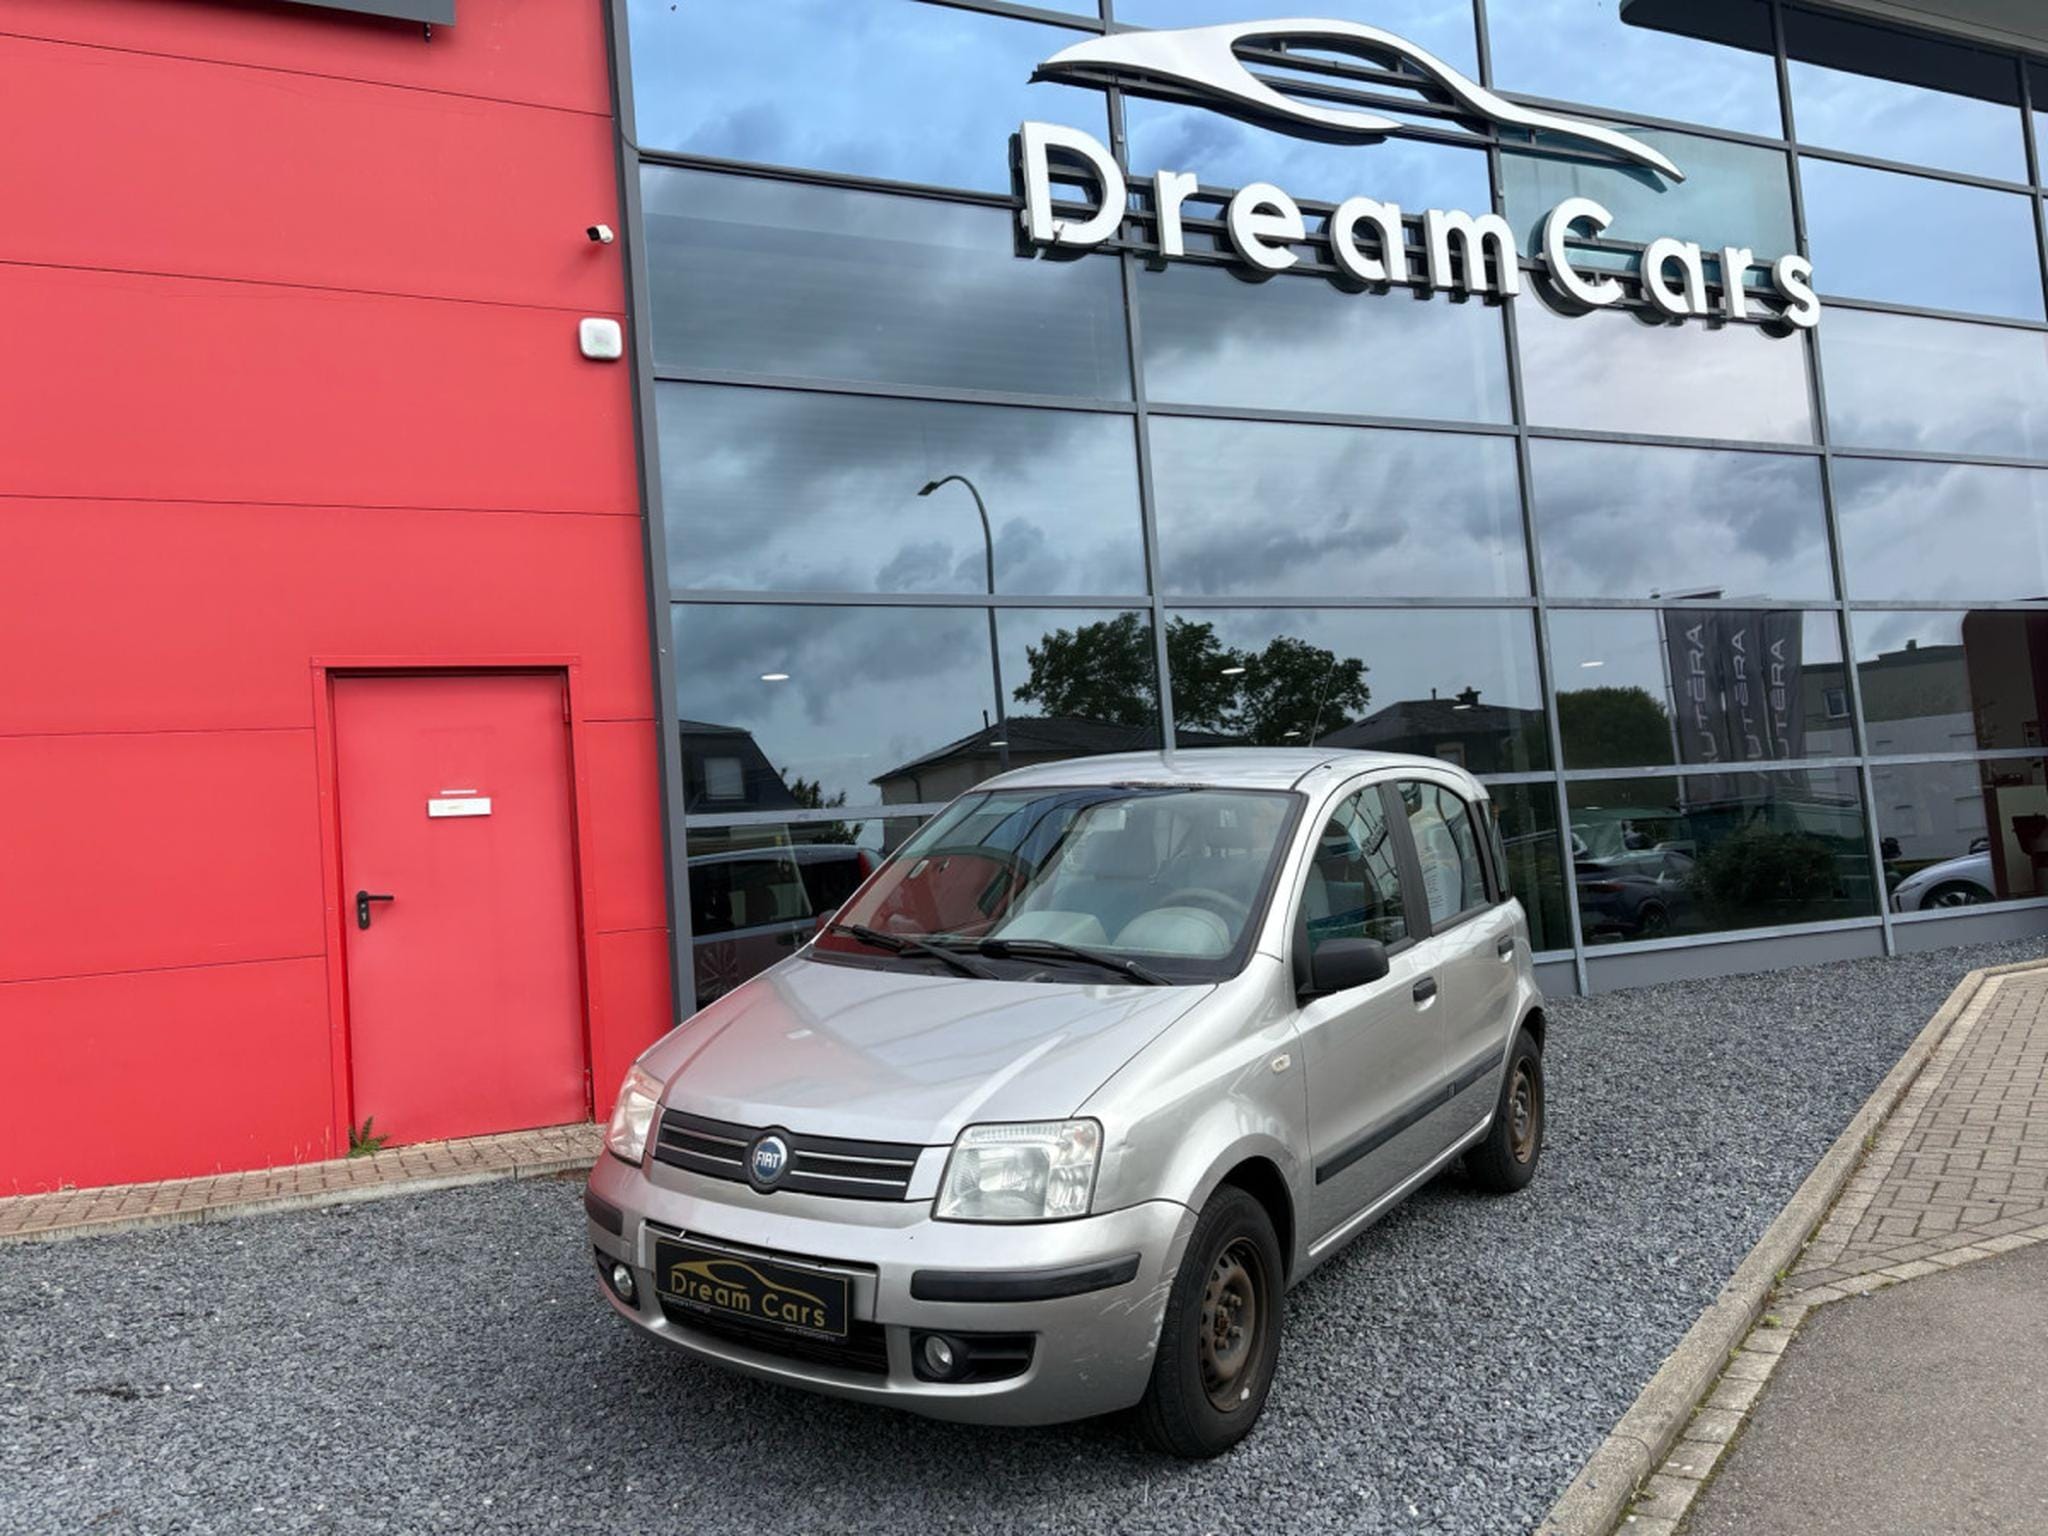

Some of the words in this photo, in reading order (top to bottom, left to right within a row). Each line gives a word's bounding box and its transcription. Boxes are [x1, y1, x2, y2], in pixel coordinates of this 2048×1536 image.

[1020, 121, 1519, 296] Dream
[1542, 197, 1820, 328] Cars
[756, 1150, 780, 1169] FIAT
[671, 1271, 750, 1312] Dream
[761, 1293, 826, 1327] Cars
